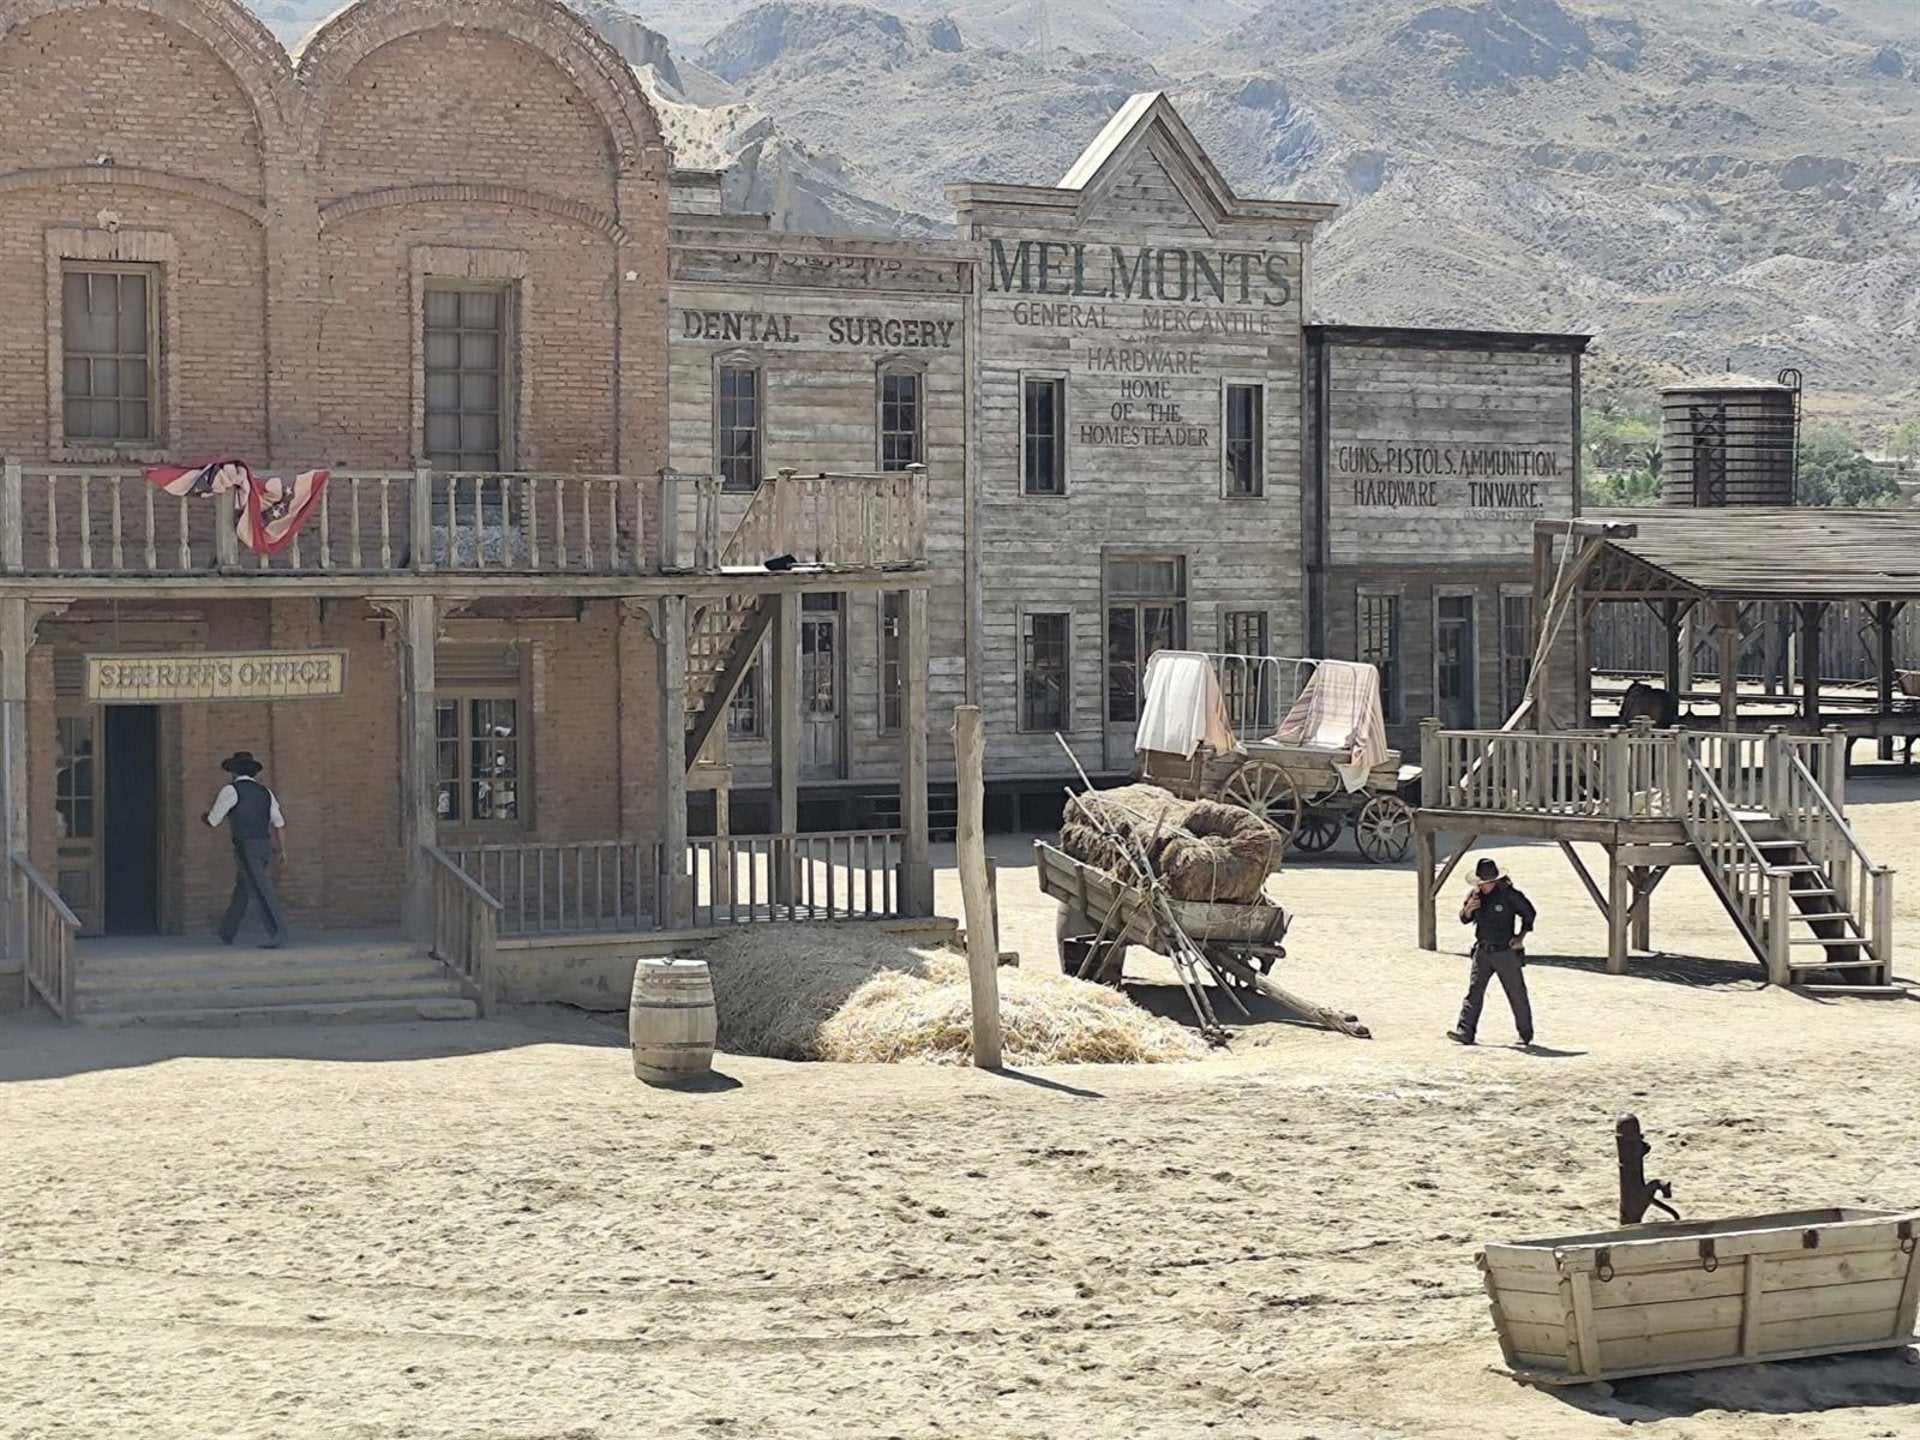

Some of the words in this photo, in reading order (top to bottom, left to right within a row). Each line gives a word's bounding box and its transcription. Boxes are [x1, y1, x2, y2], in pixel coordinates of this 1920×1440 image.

[683, 310, 799, 343] DENTAL
[828, 316, 956, 348] SURGERY
[1013, 301, 1116, 329] GENERAL
[1141, 307, 1271, 334] MERCANTILE
[1087, 346, 1202, 374] HARDWARE
[1120, 379, 1171, 399] HOME
[1110, 402, 1133, 422] OF
[1147, 403, 1182, 423] THE
[1080, 424, 1209, 447] HOMESTEADER
[1353, 480, 1437, 507] HARDWARE
[1467, 481, 1544, 509] TINWARE.
[238, 660, 331, 686] OFFICE
